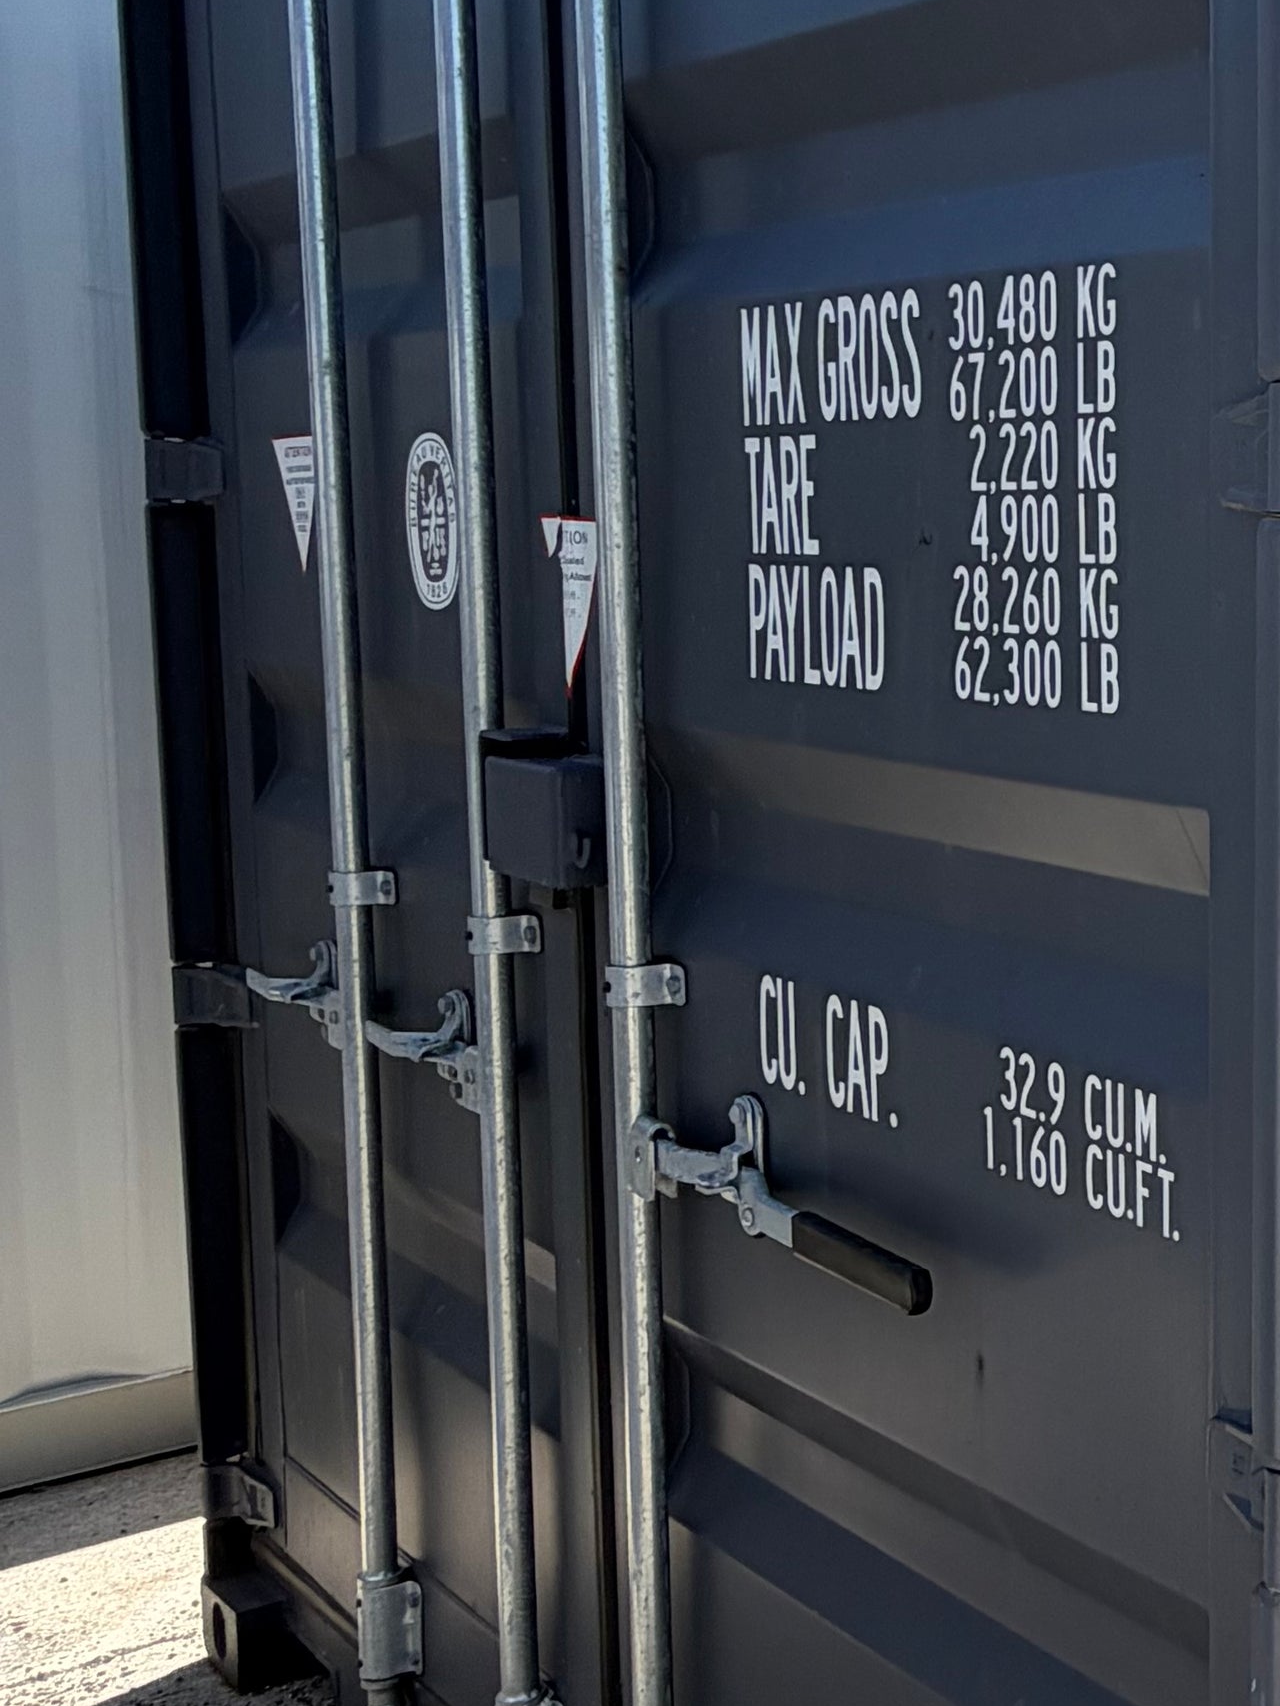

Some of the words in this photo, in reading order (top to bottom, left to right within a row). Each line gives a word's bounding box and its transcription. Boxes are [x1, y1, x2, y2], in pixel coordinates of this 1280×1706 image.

[741, 302, 806, 426] MAX
[818, 289, 921, 421] GROSS
[949, 271, 1056, 350] 30,480
[1078, 263, 1116, 338] KG
[950, 346, 1057, 422] 67,200
[1078, 341, 1115, 413] LB
[745, 435, 819, 555] TARE
[970, 421, 1058, 494] 2,220
[1078, 417, 1116, 489] KG
[971, 494, 1058, 565] 4,900
[1078, 493, 1116, 564] LB
[749, 564, 884, 690] PAYLOAD
[954, 566, 1060, 635] 28,260
[1080, 568, 1118, 639] KG
[956, 636, 1061, 708] 62,300
[1081, 642, 1119, 713] LB
[760, 975, 805, 1095] CU.
[827, 995, 897, 1127] CAP.
[1000, 1047, 1064, 1124] 32.9
[1085, 1075, 1166, 1164] CU.M.
[984, 1105, 1066, 1195] 1,160
[1086, 1144, 1179, 1241] CU.FT.
